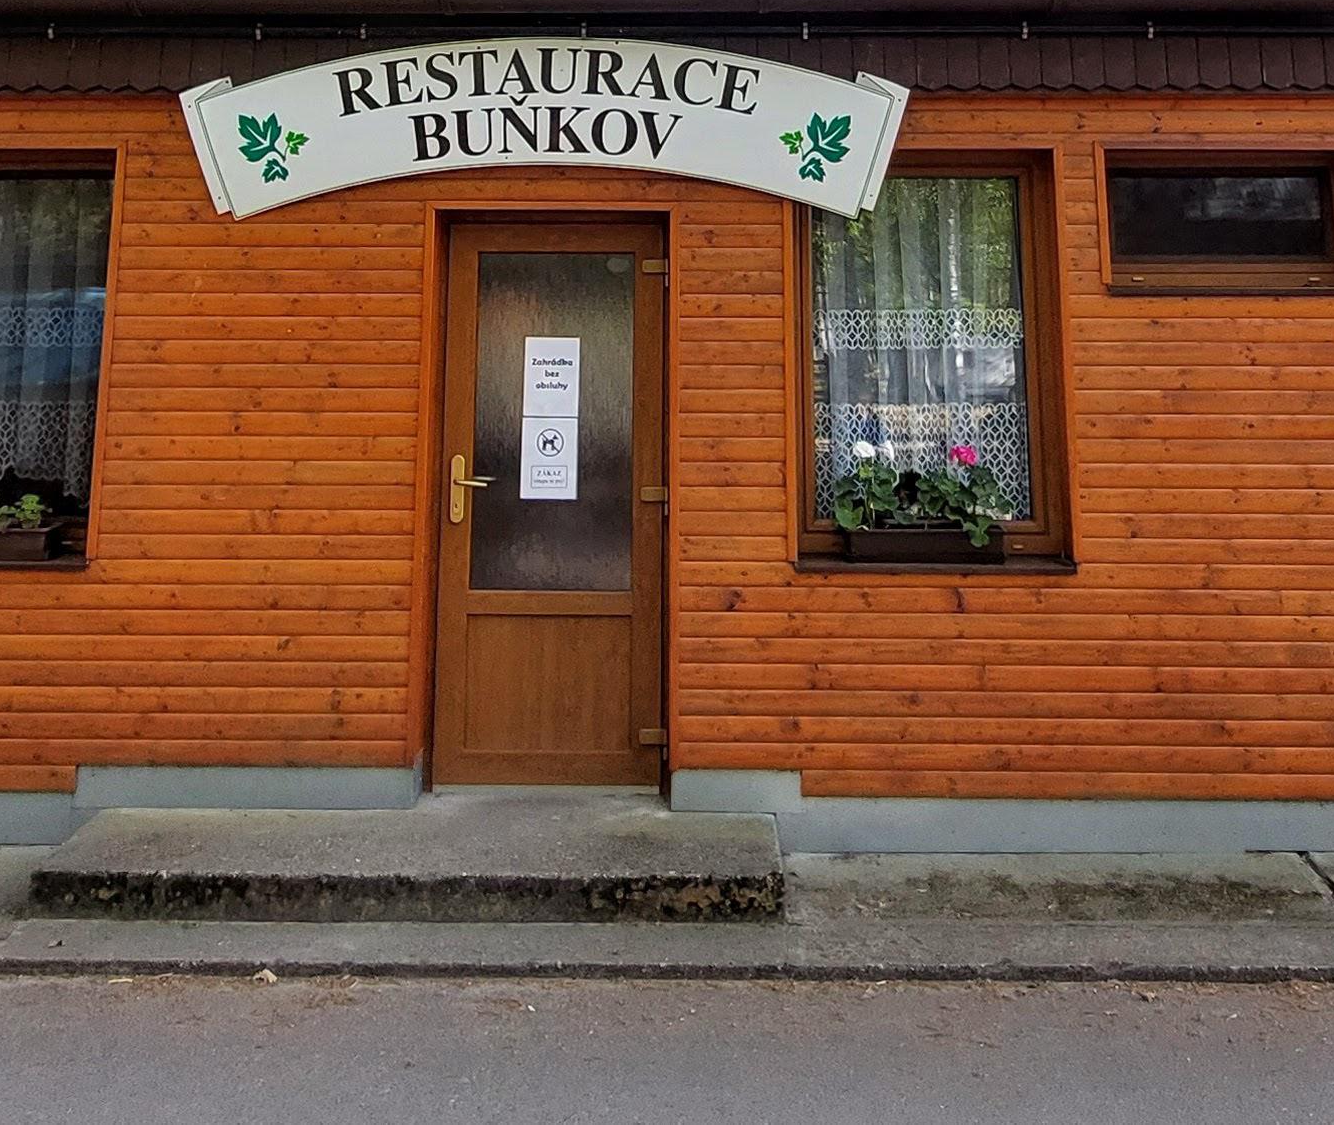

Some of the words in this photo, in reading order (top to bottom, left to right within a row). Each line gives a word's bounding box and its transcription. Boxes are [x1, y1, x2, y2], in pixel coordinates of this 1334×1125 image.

[332, 47, 760, 117] RESTAURACE
[409, 95, 683, 162] BUŇKOV
[535, 380, 568, 390] obsluhy
[544, 369, 559, 377] bez
